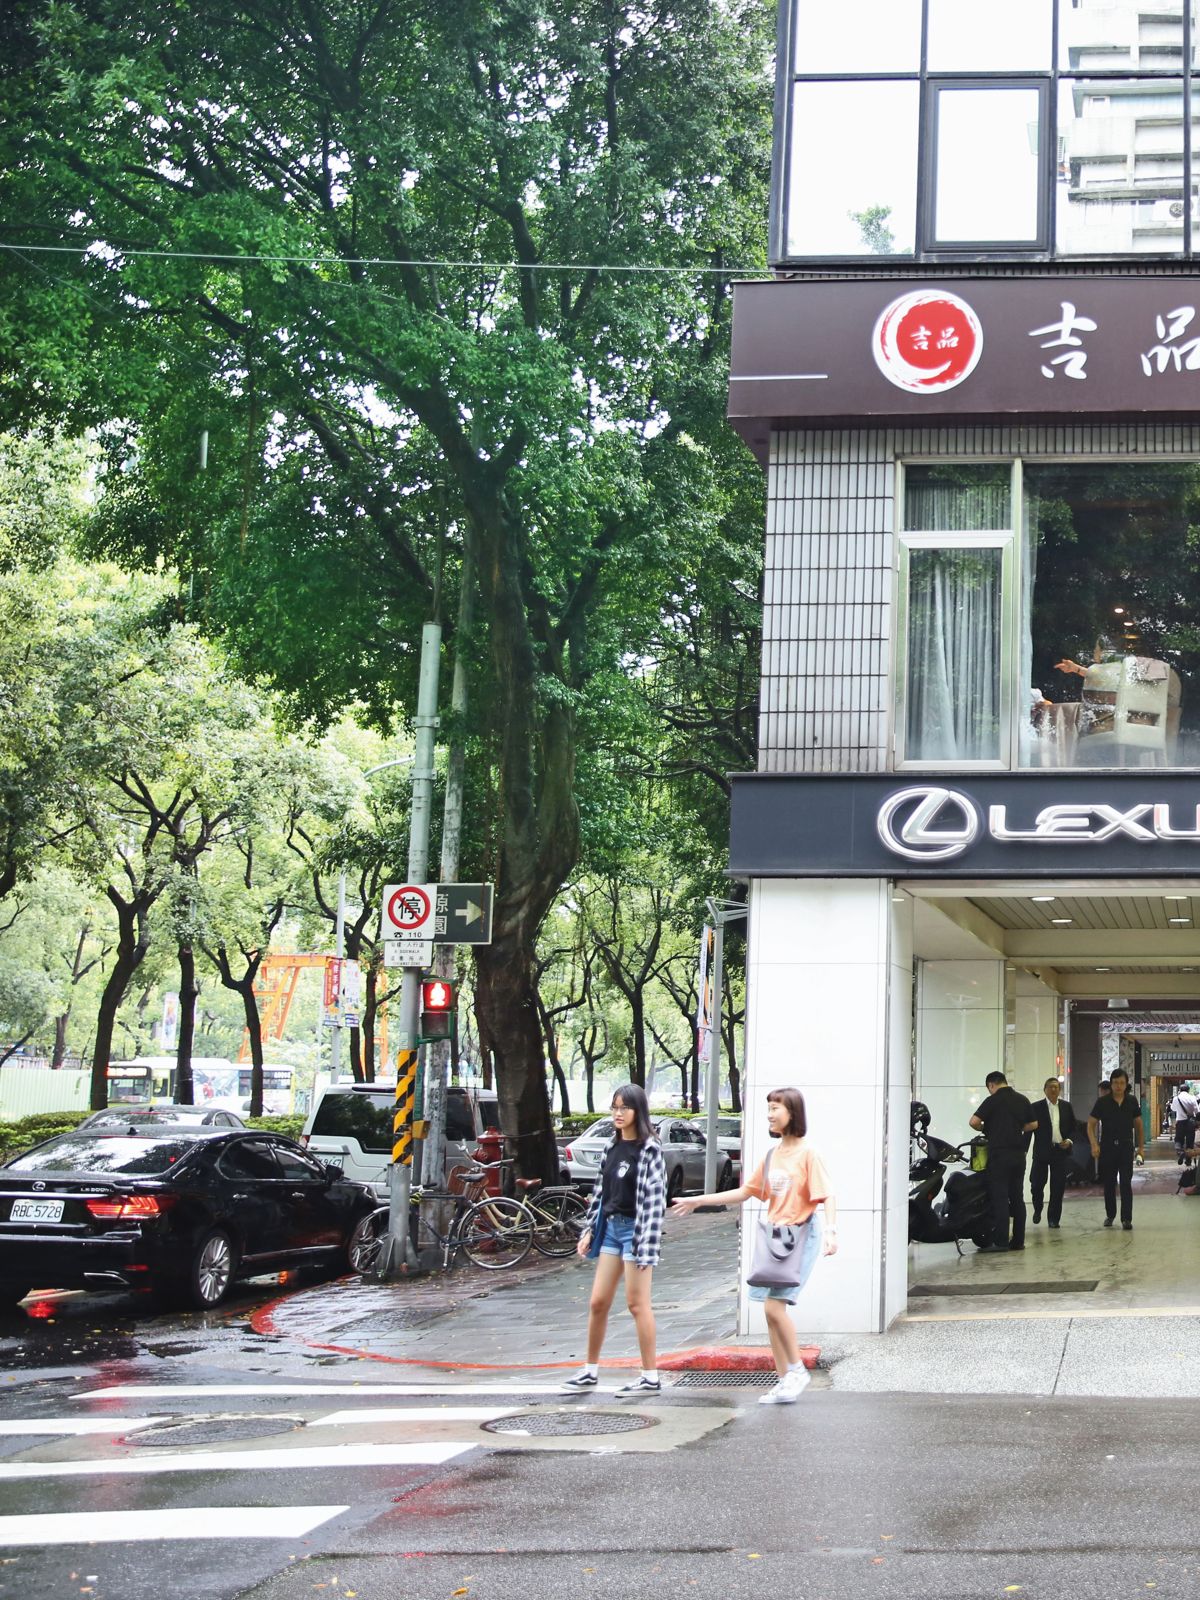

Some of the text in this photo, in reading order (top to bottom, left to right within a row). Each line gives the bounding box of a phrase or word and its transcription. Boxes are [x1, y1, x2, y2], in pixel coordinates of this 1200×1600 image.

[910, 325, 960, 350] 吉品
[398, 897, 421, 920] 停
[1163, 1063, 1183, 1072] Medi
